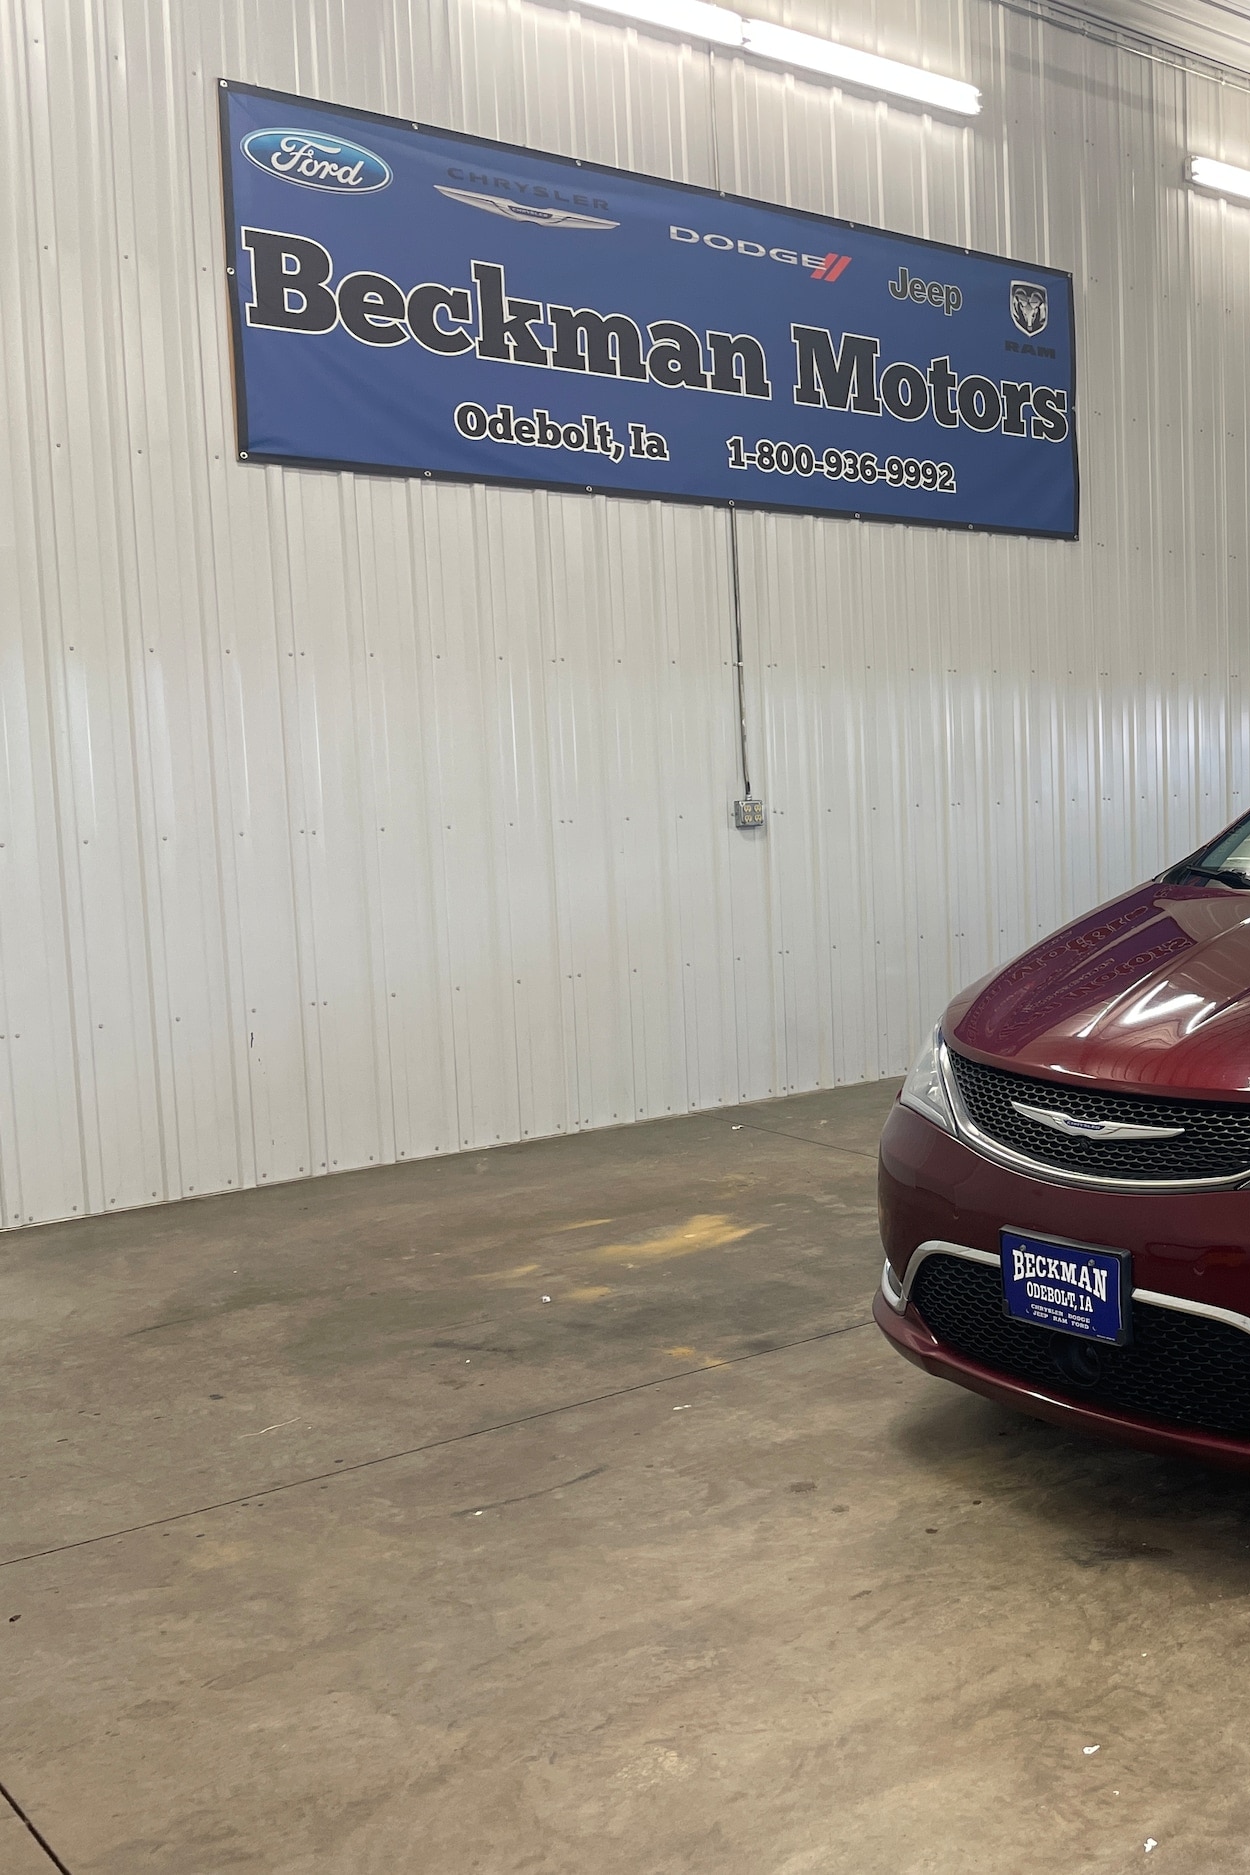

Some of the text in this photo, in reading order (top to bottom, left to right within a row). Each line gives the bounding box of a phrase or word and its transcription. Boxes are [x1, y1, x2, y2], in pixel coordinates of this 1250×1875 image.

[270, 136, 364, 187] Ford
[447, 167, 610, 211] CHRYSLER
[669, 225, 828, 270] DODGE
[888, 267, 963, 316] Jeep
[241, 226, 1069, 443] Beckman Motors
[1004, 340, 1056, 359] RAM
[454, 401, 670, 464] Odebolt, Ia
[726, 435, 957, 493] 1-800-936-9992
[1012, 1249, 1108, 1302] BECKMAN
[1026, 1281, 1094, 1313] ODEBOLT, IA
[1031, 1303, 1091, 1324] CHRYSLER DODGE
[1033, 1311, 1090, 1330] JEEP RAM FORD
